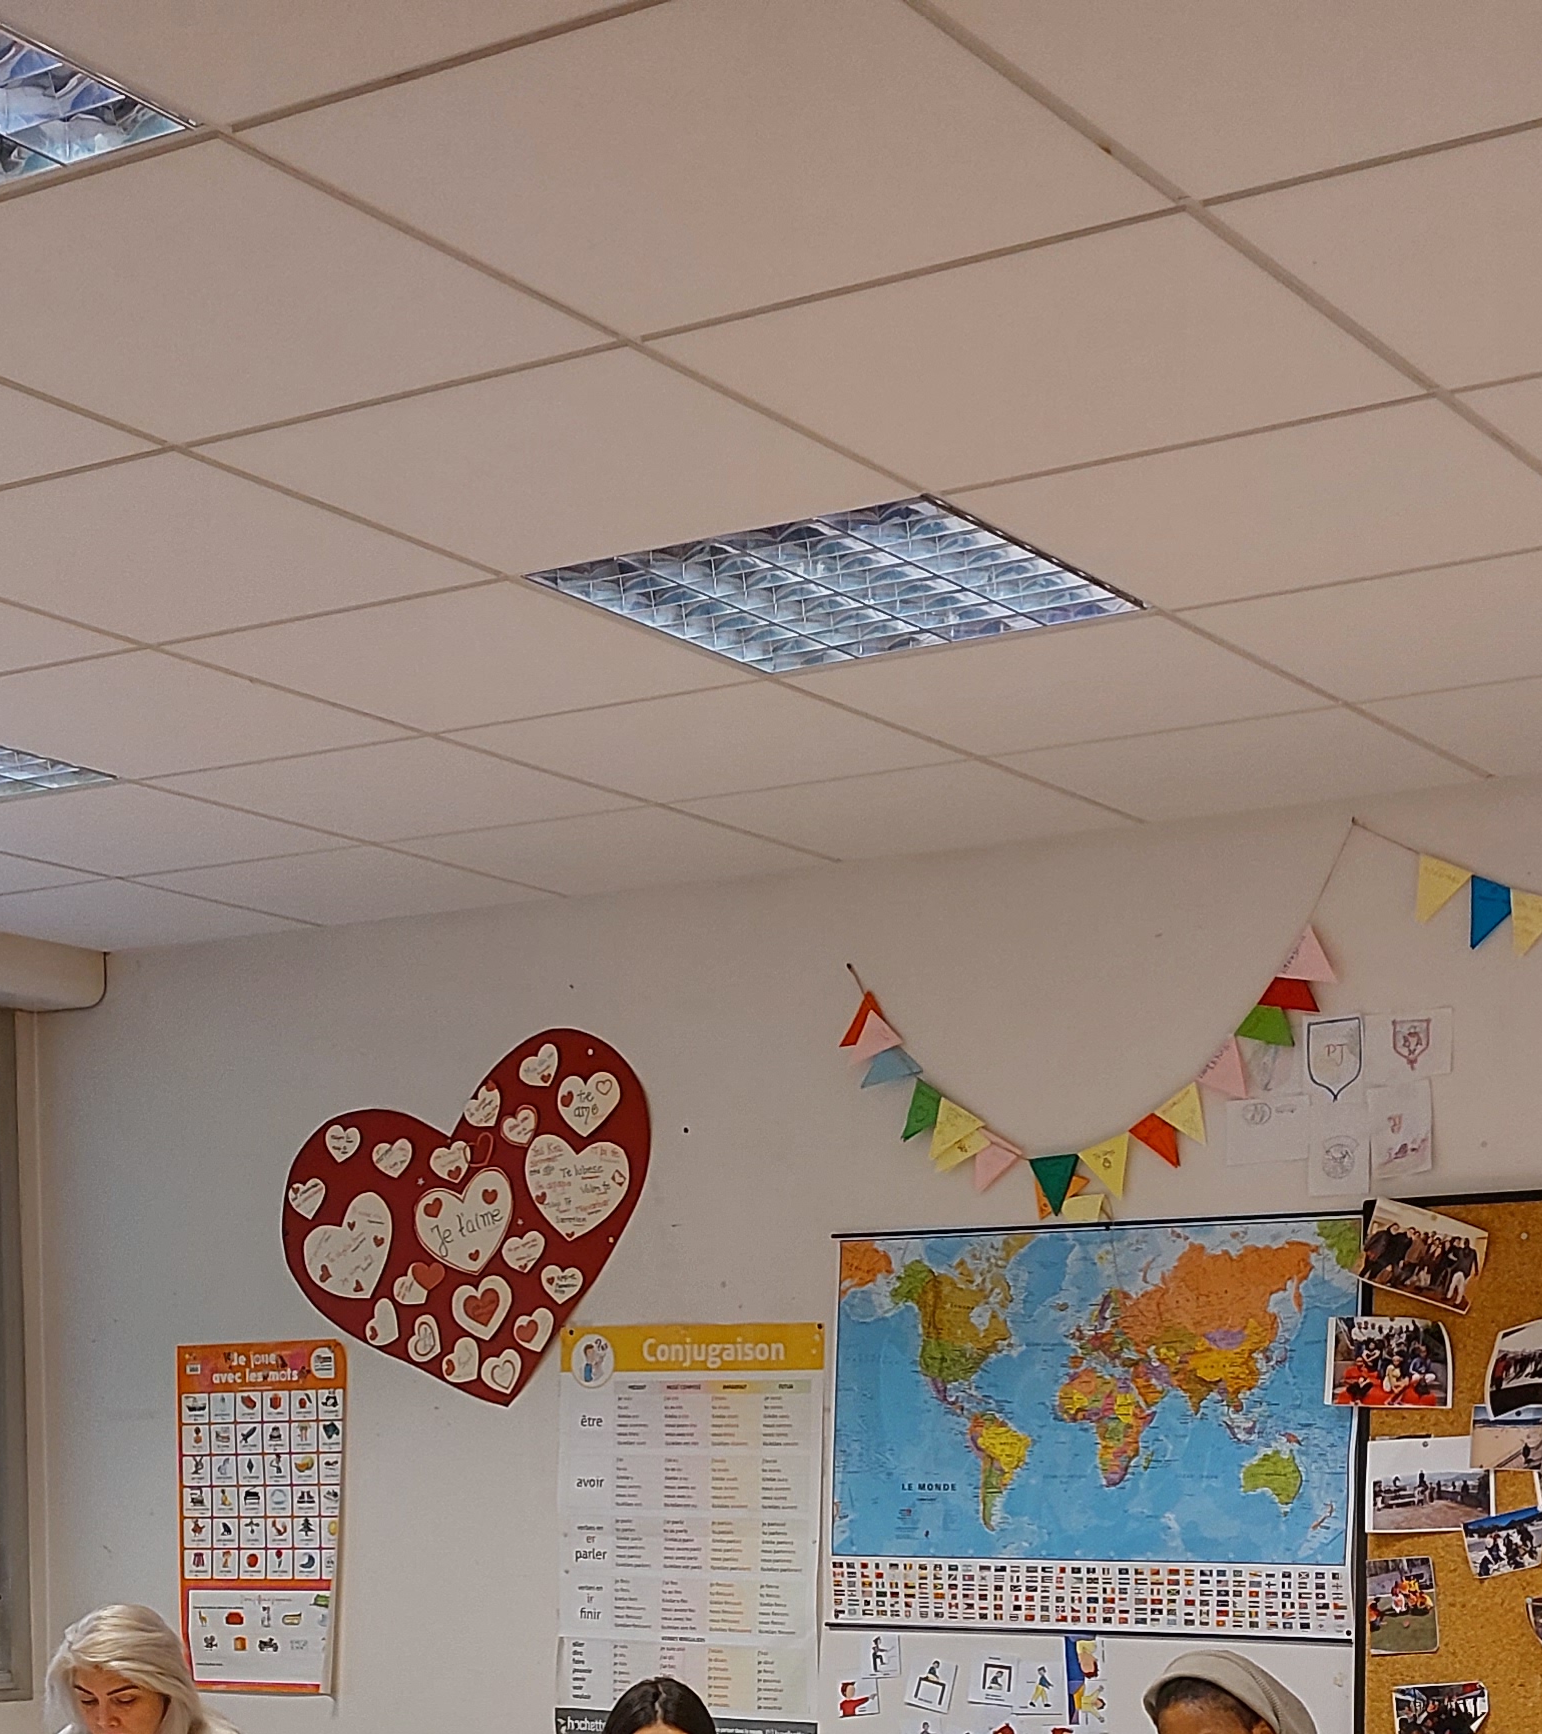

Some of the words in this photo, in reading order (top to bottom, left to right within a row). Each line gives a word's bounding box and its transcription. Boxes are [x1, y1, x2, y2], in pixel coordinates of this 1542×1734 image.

[431, 1223, 455, 1258] Je
[458, 1207, 505, 1238] t'aime
[642, 1338, 786, 1369] Conjugaison
[212, 1371, 243, 1384] avec
[267, 1367, 299, 1382] mots
[580, 1415, 603, 1428] être
[576, 1476, 605, 1489] avoir
[901, 1483, 913, 1491] LE
[917, 1483, 957, 1491] MONDE
[575, 1548, 608, 1562] parler
[579, 1607, 602, 1620] finir
